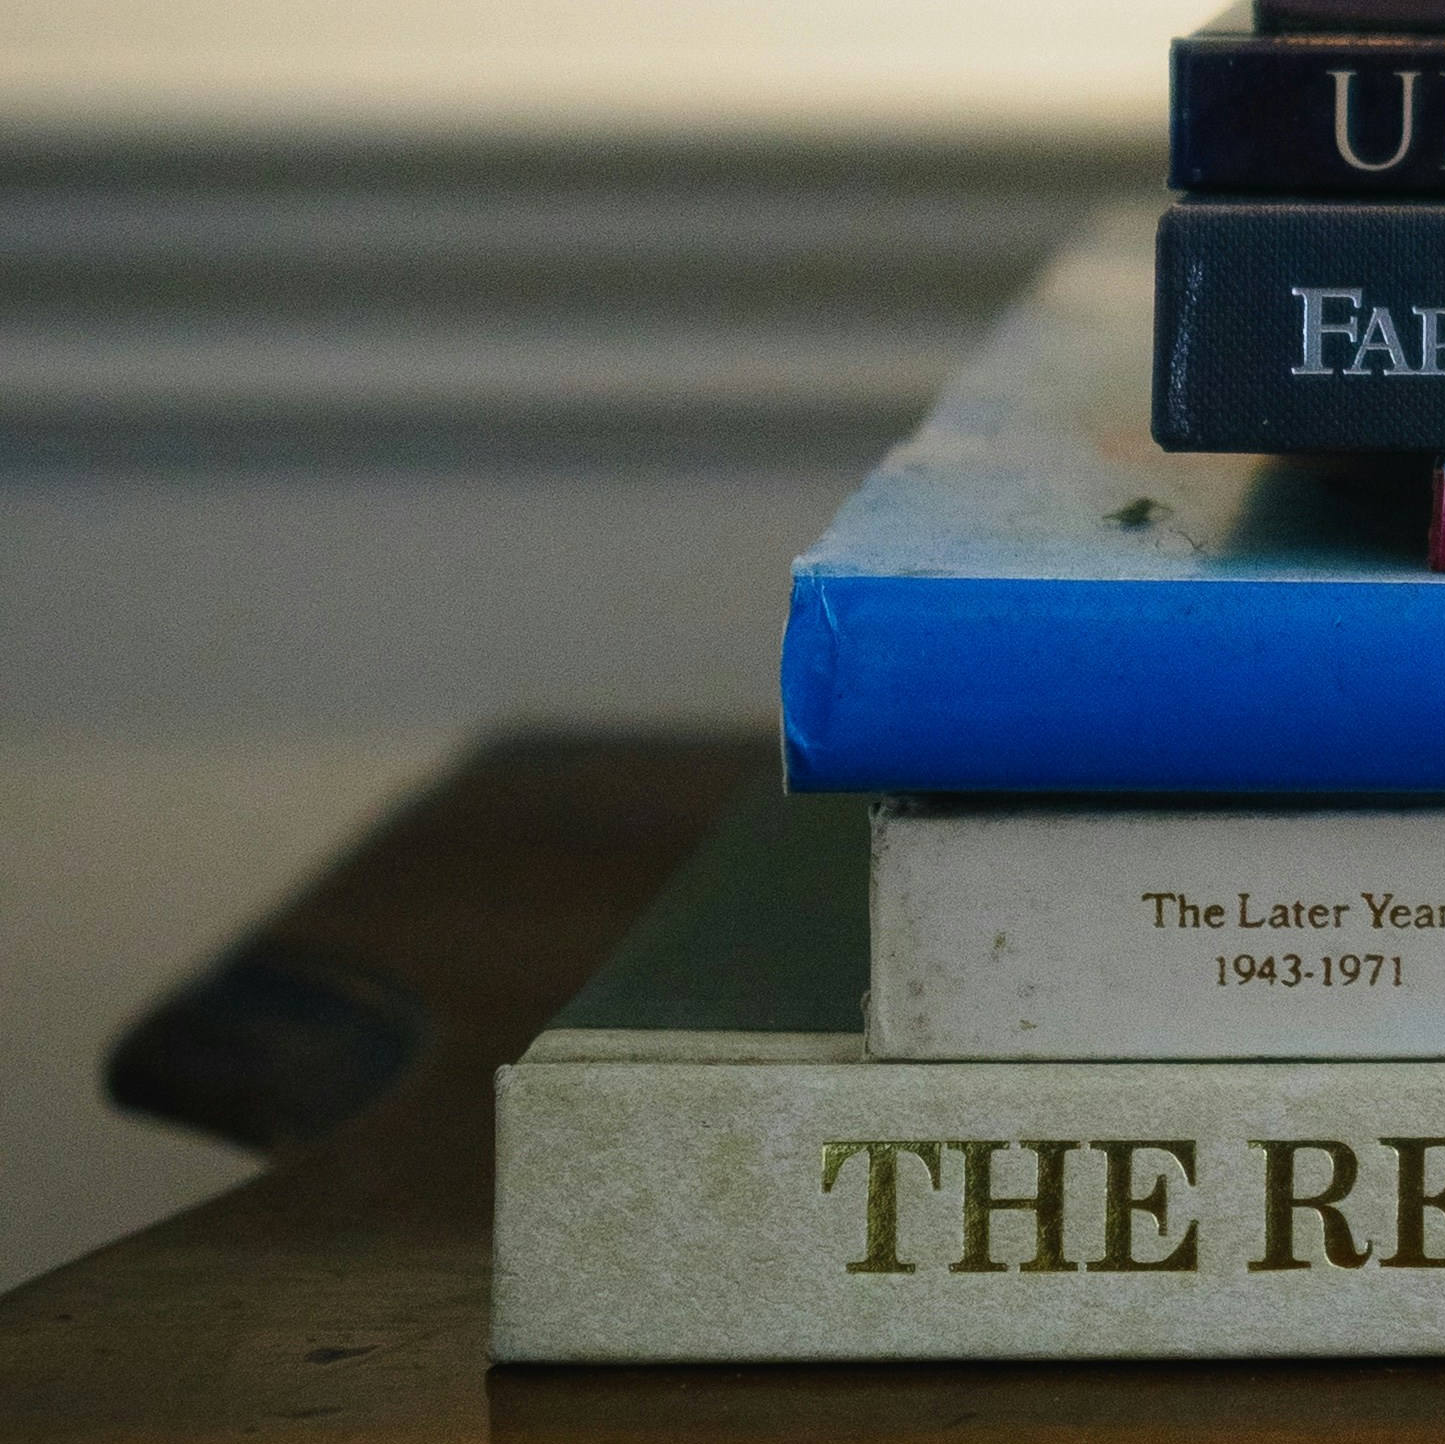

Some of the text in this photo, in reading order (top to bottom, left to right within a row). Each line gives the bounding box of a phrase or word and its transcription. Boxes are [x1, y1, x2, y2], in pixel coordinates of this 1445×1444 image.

[1142, 892, 1226, 930] The
[1238, 892, 1350, 930] Later
[1214, 953, 1404, 989] 1943-1971
[820, 1139, 1199, 1272] THE
